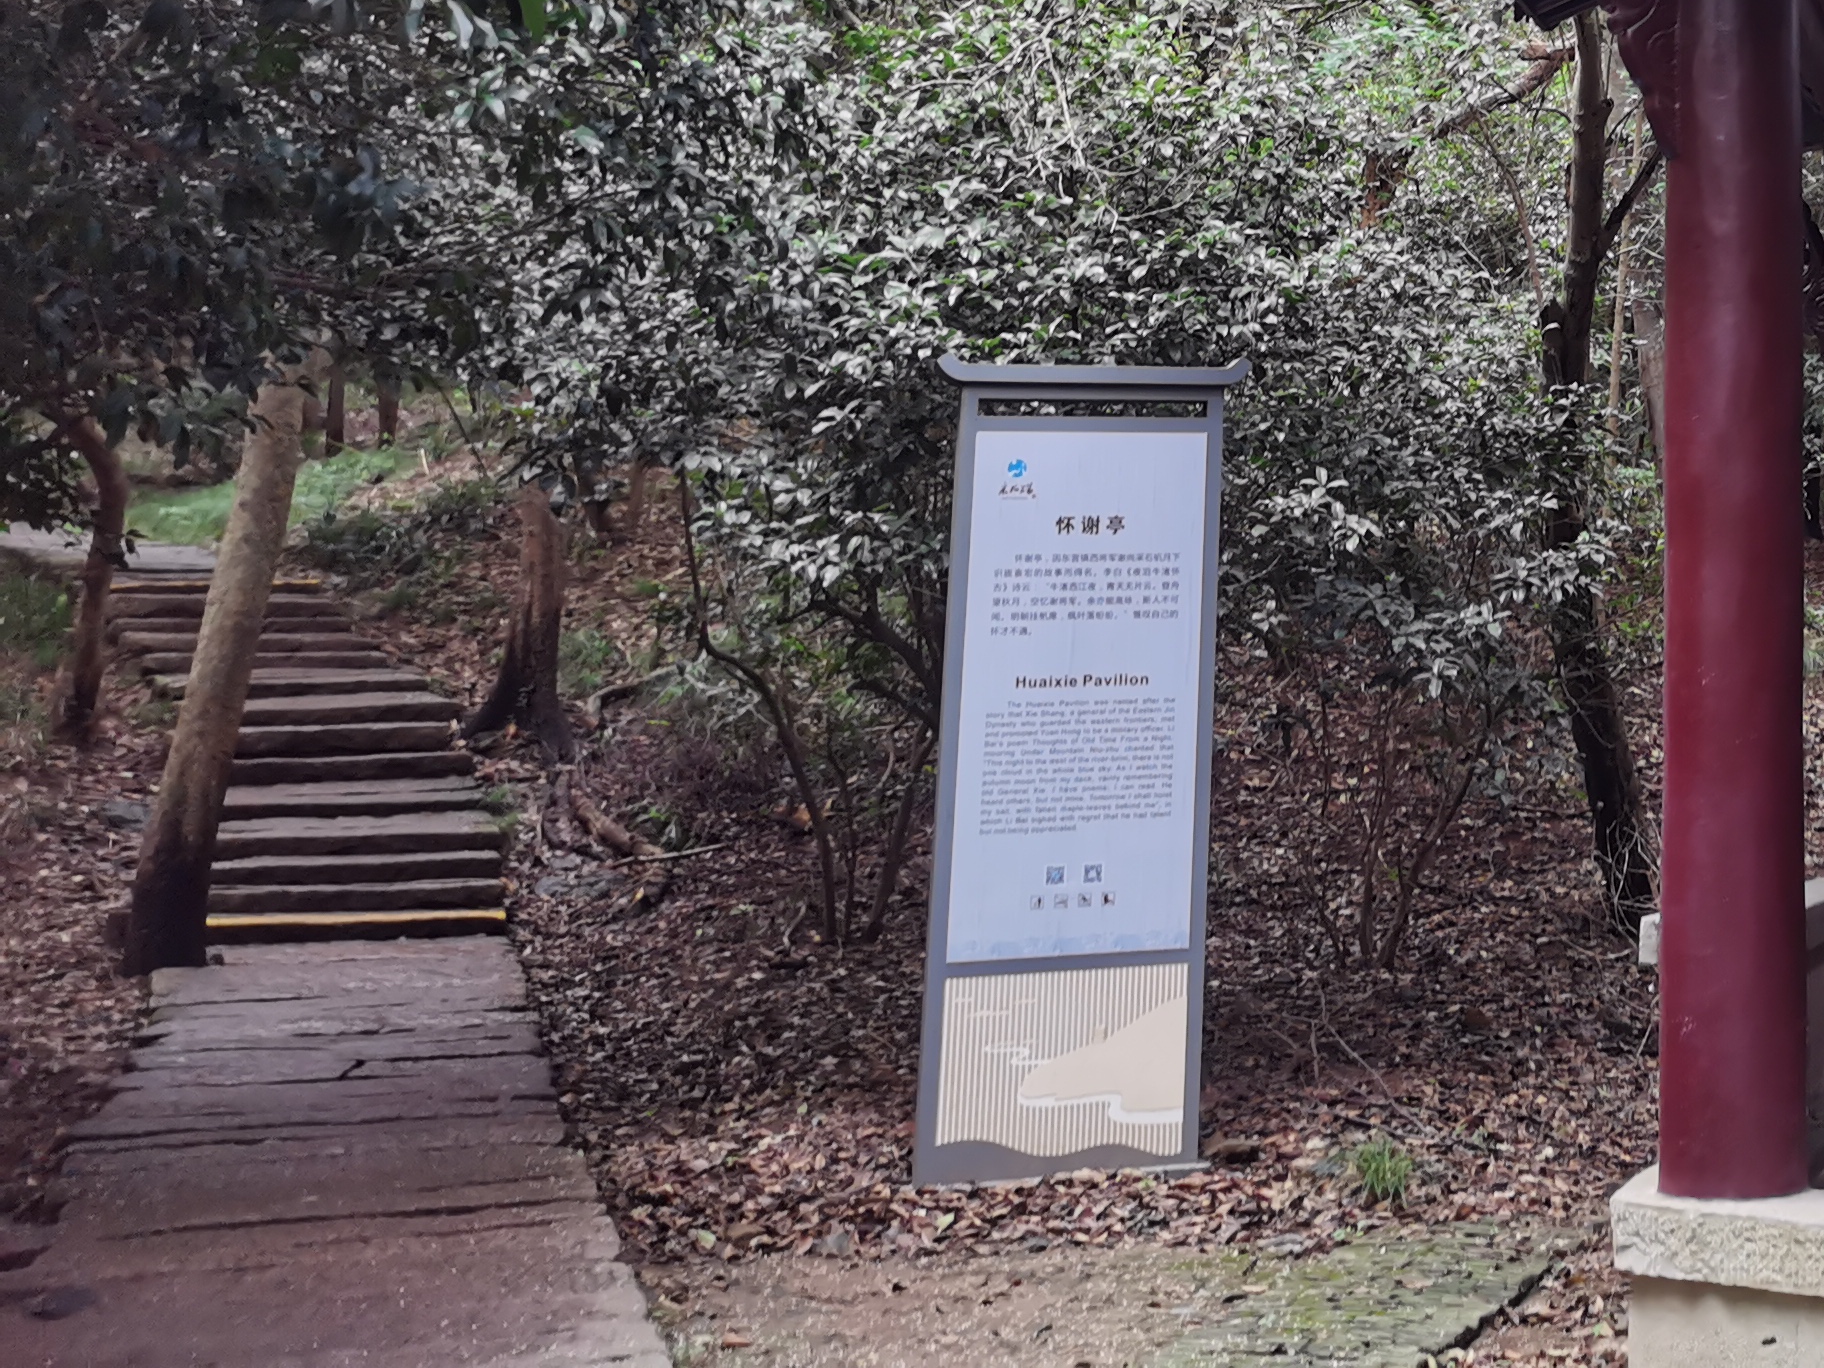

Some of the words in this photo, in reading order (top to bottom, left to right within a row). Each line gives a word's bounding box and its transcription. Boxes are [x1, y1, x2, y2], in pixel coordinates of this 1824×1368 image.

[1056, 515, 1125, 535] 怀谢亭
[1015, 675, 1078, 689] Huaixie
[1083, 673, 1149, 687] Pavilion
